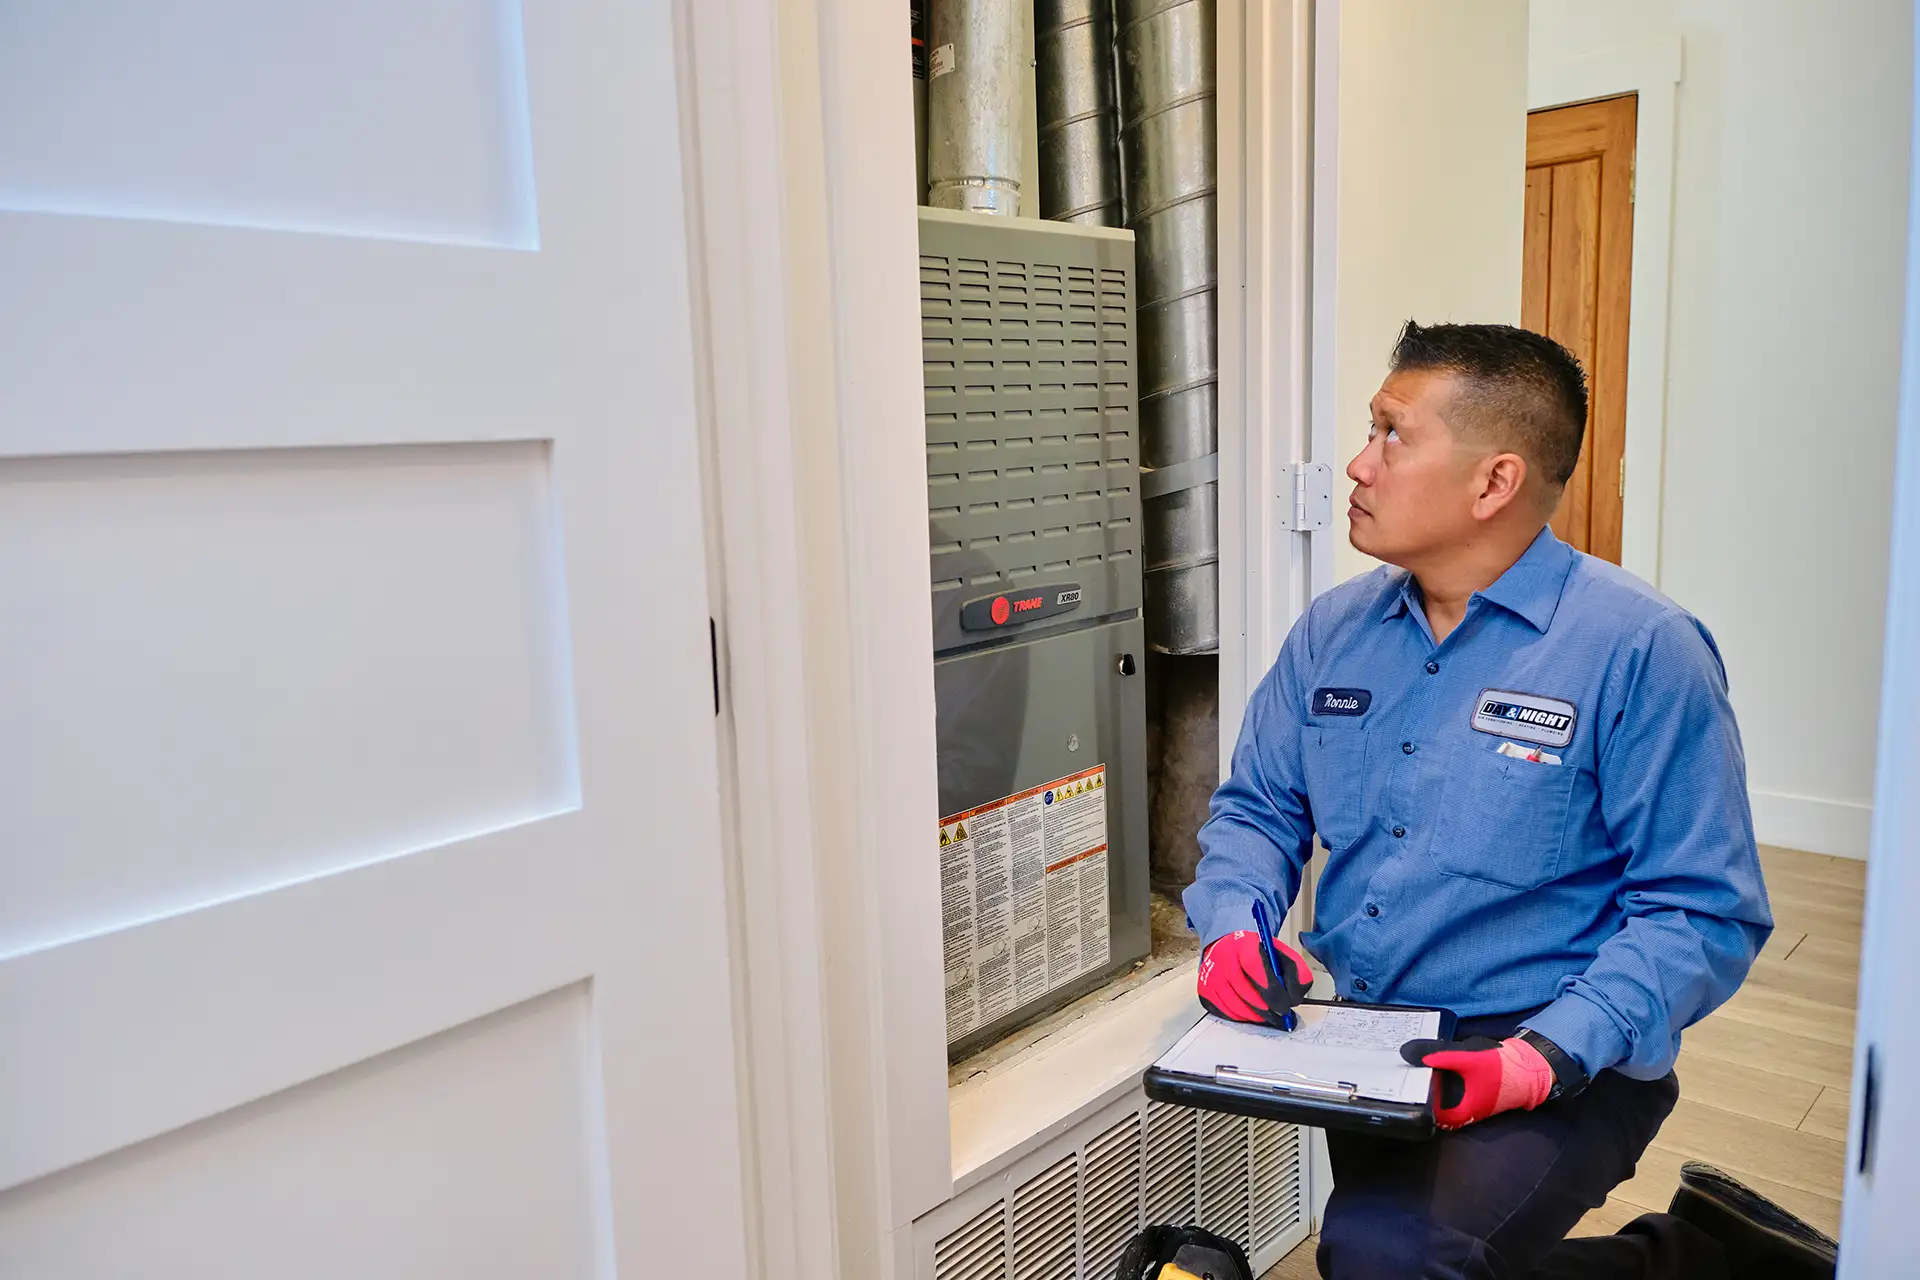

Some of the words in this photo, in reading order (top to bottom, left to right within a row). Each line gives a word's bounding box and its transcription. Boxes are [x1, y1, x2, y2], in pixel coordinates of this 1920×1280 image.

[1013, 597, 1043, 612] TRANE
[1060, 592, 1079, 603] XR80
[1324, 693, 1359, 709] Ronnie
